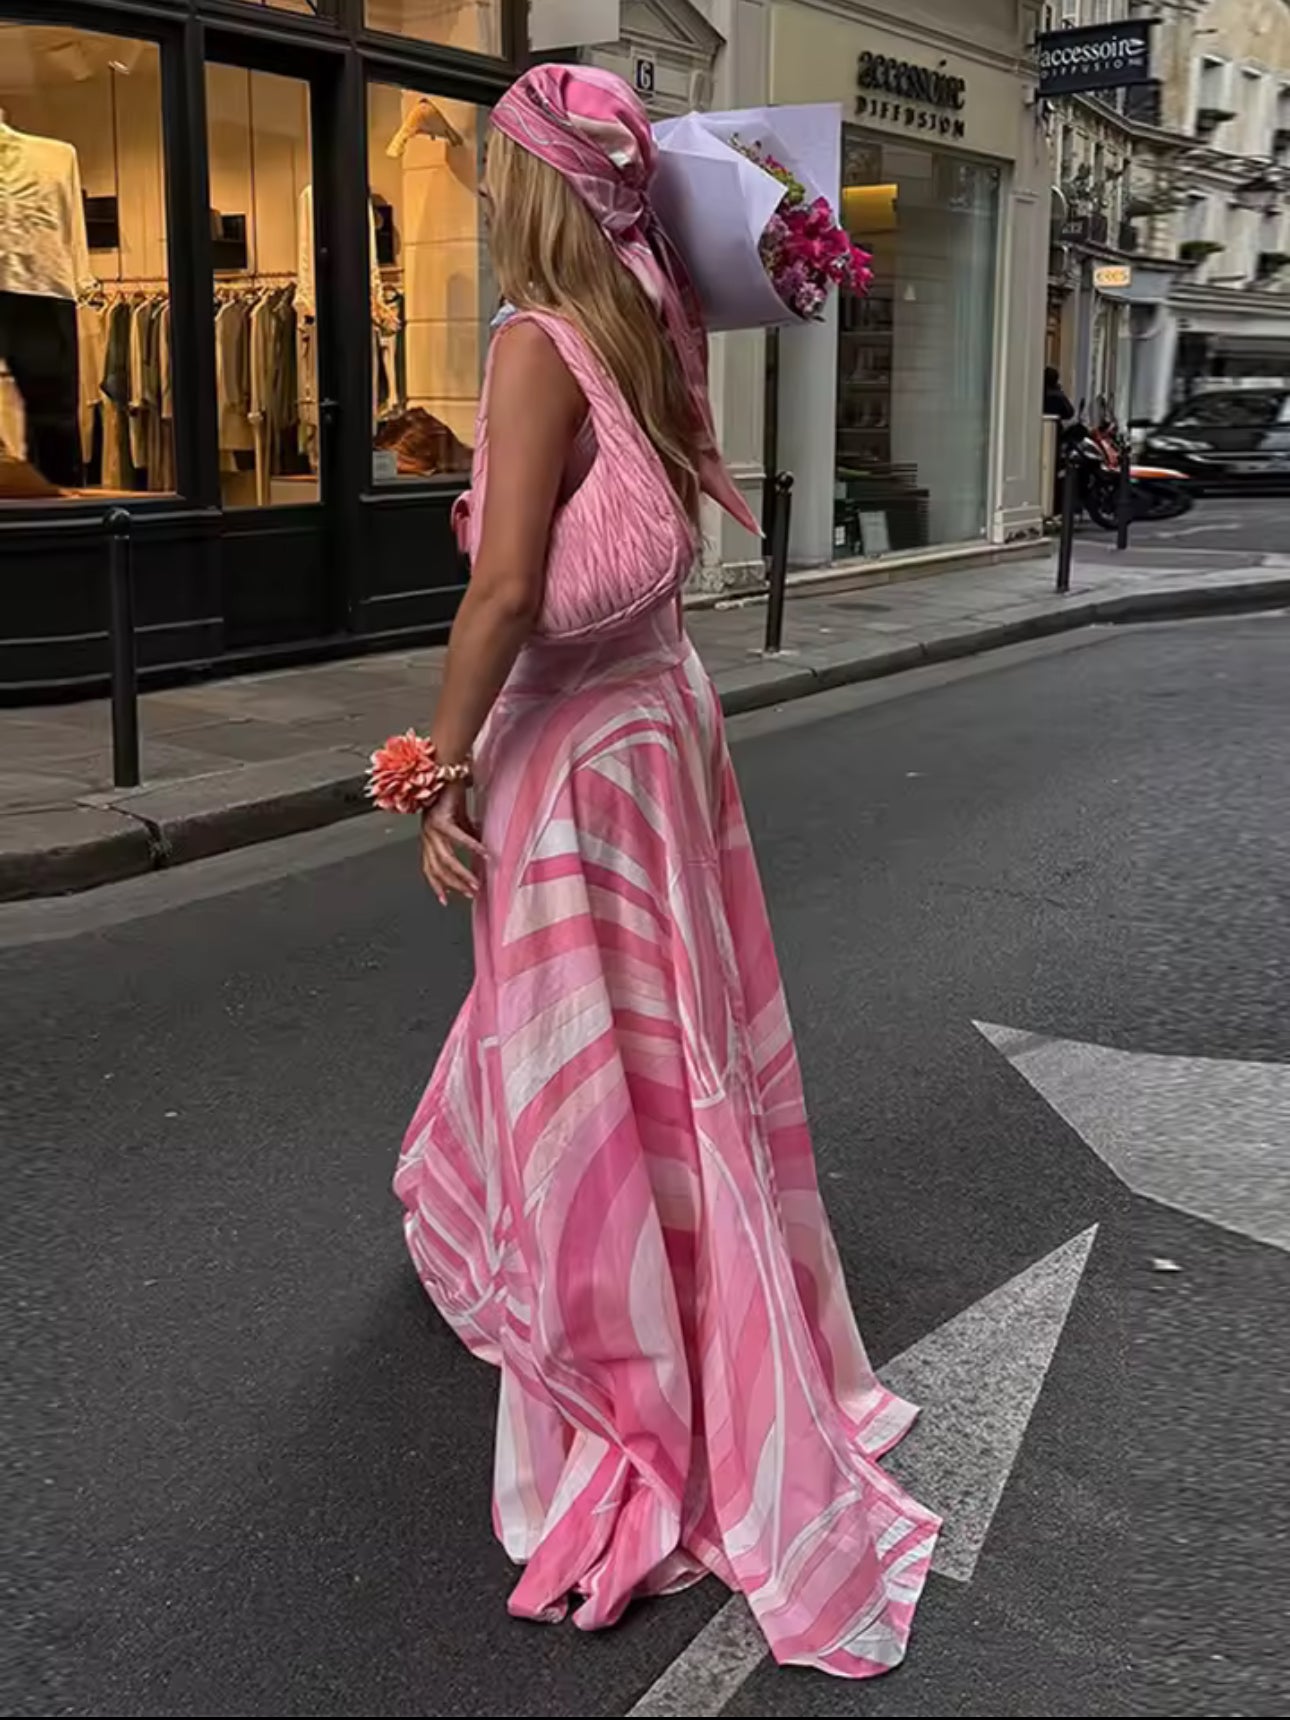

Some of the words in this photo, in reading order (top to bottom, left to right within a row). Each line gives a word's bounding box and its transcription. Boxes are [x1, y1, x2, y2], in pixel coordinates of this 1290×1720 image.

[1040, 35, 1145, 68] accessoire
[641, 61, 652, 89] 6
[855, 95, 965, 138] DIFFUSION
